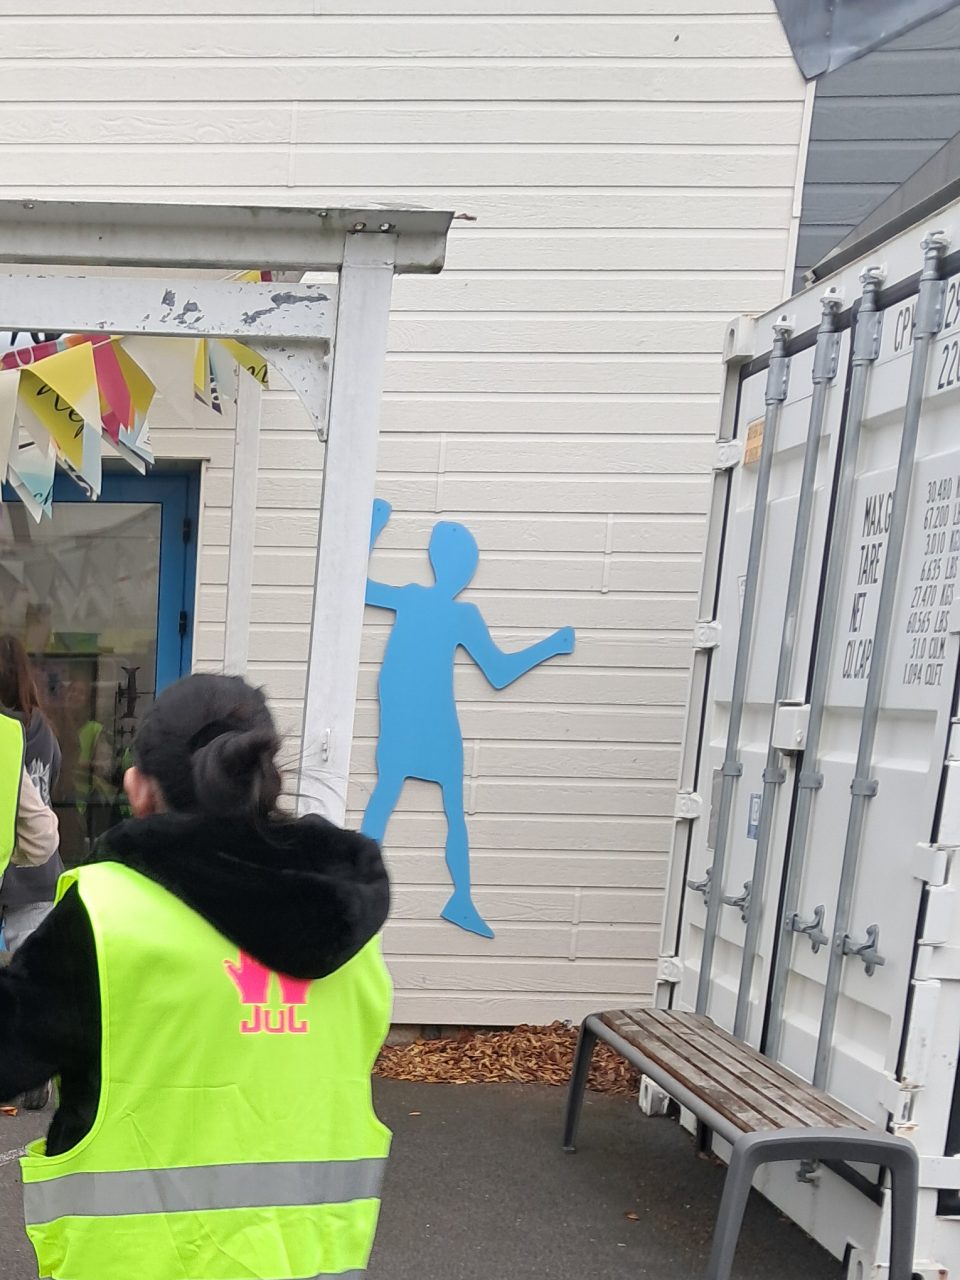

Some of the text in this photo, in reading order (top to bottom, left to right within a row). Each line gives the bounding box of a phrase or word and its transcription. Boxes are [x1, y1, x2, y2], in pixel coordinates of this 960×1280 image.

[862, 491, 894, 537] MAX.G
[857, 541, 883, 586] TARE
[848, 592, 867, 633] NET
